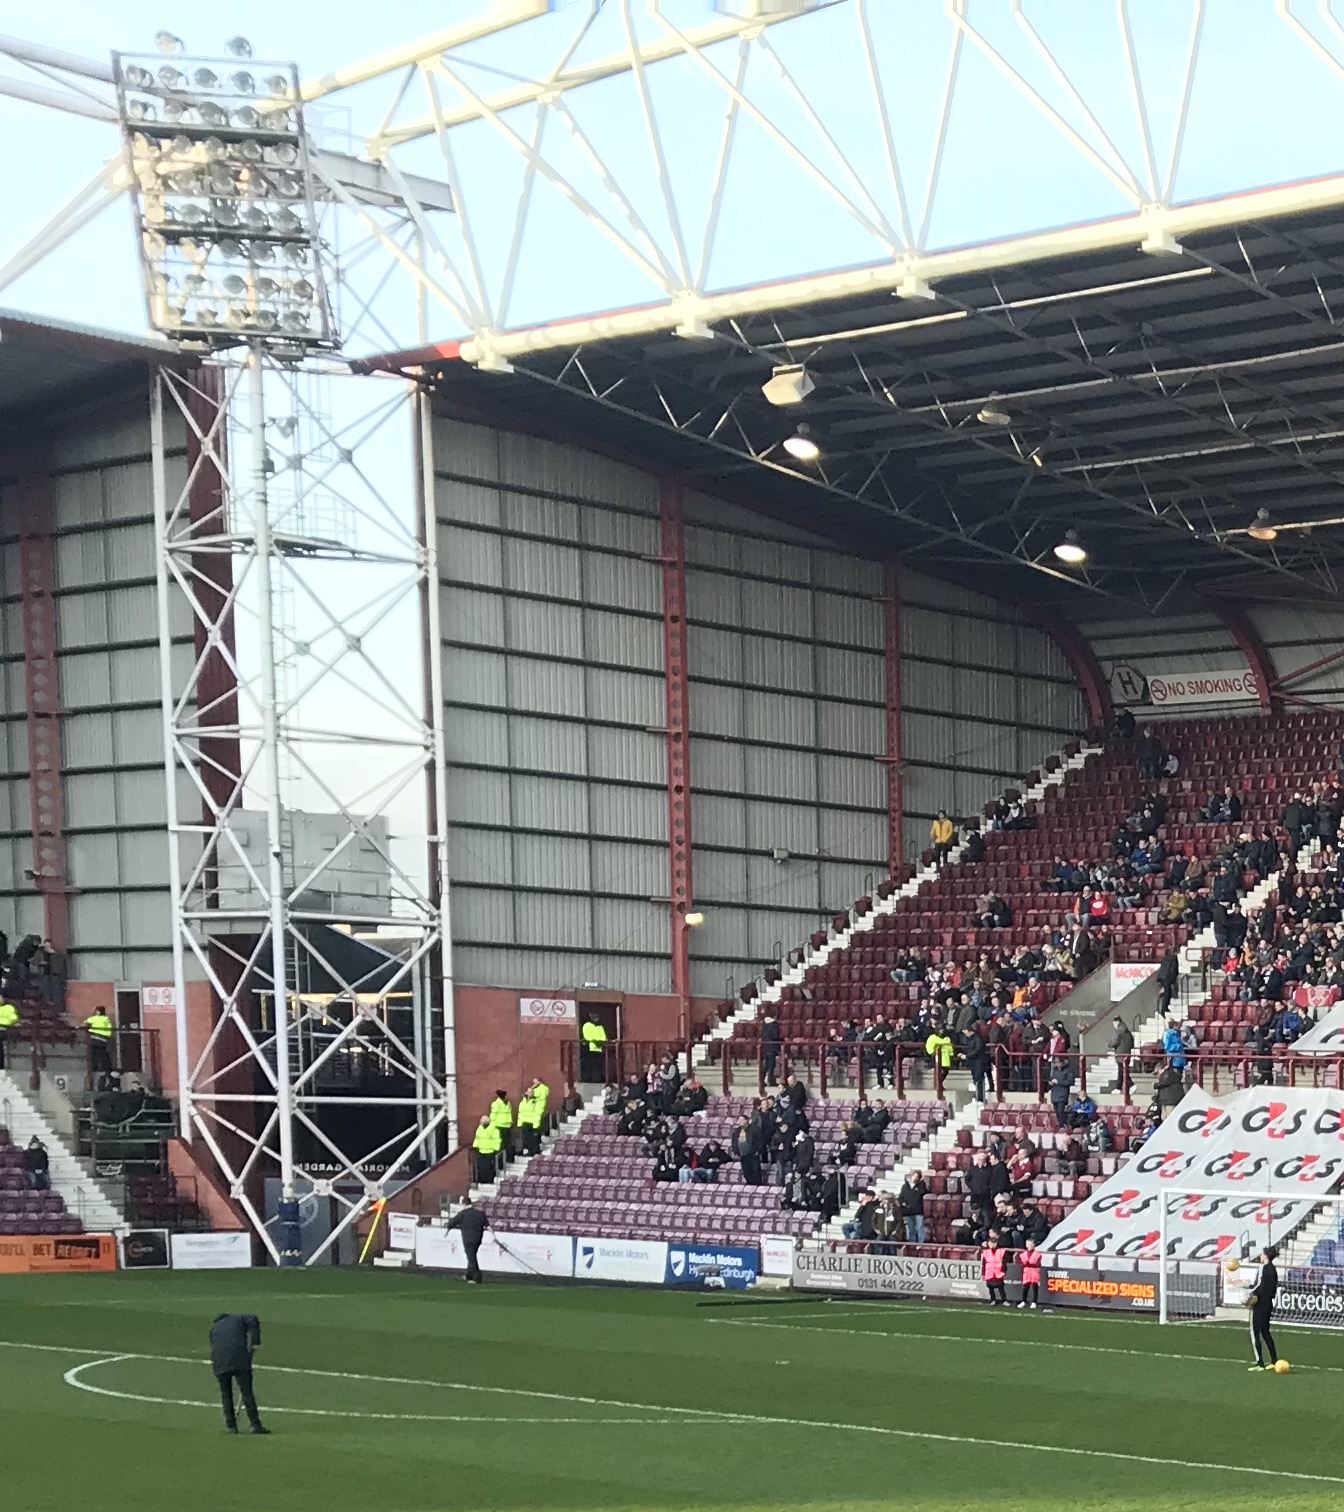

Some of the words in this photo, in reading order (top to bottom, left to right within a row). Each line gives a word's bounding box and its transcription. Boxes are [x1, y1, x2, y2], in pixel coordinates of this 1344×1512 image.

[1117, 671, 1138, 695] H
[1167, 681, 1186, 696] NO
[1188, 677, 1243, 695] SMOKING
[689, 1252, 716, 1264] Macklin
[717, 1254, 743, 1266] Motors
[796, 1255, 863, 1273] CHARLIE
[867, 1259, 913, 1277] IRONS
[916, 1262, 983, 1281] COACHE
[858, 1278, 877, 1289] 0131
[880, 1279, 896, 1290] 441
[899, 1280, 925, 1292] 2222
[1047, 1279, 1119, 1296] SPECIALIZED
[1119, 1282, 1155, 1297] SIGNS
